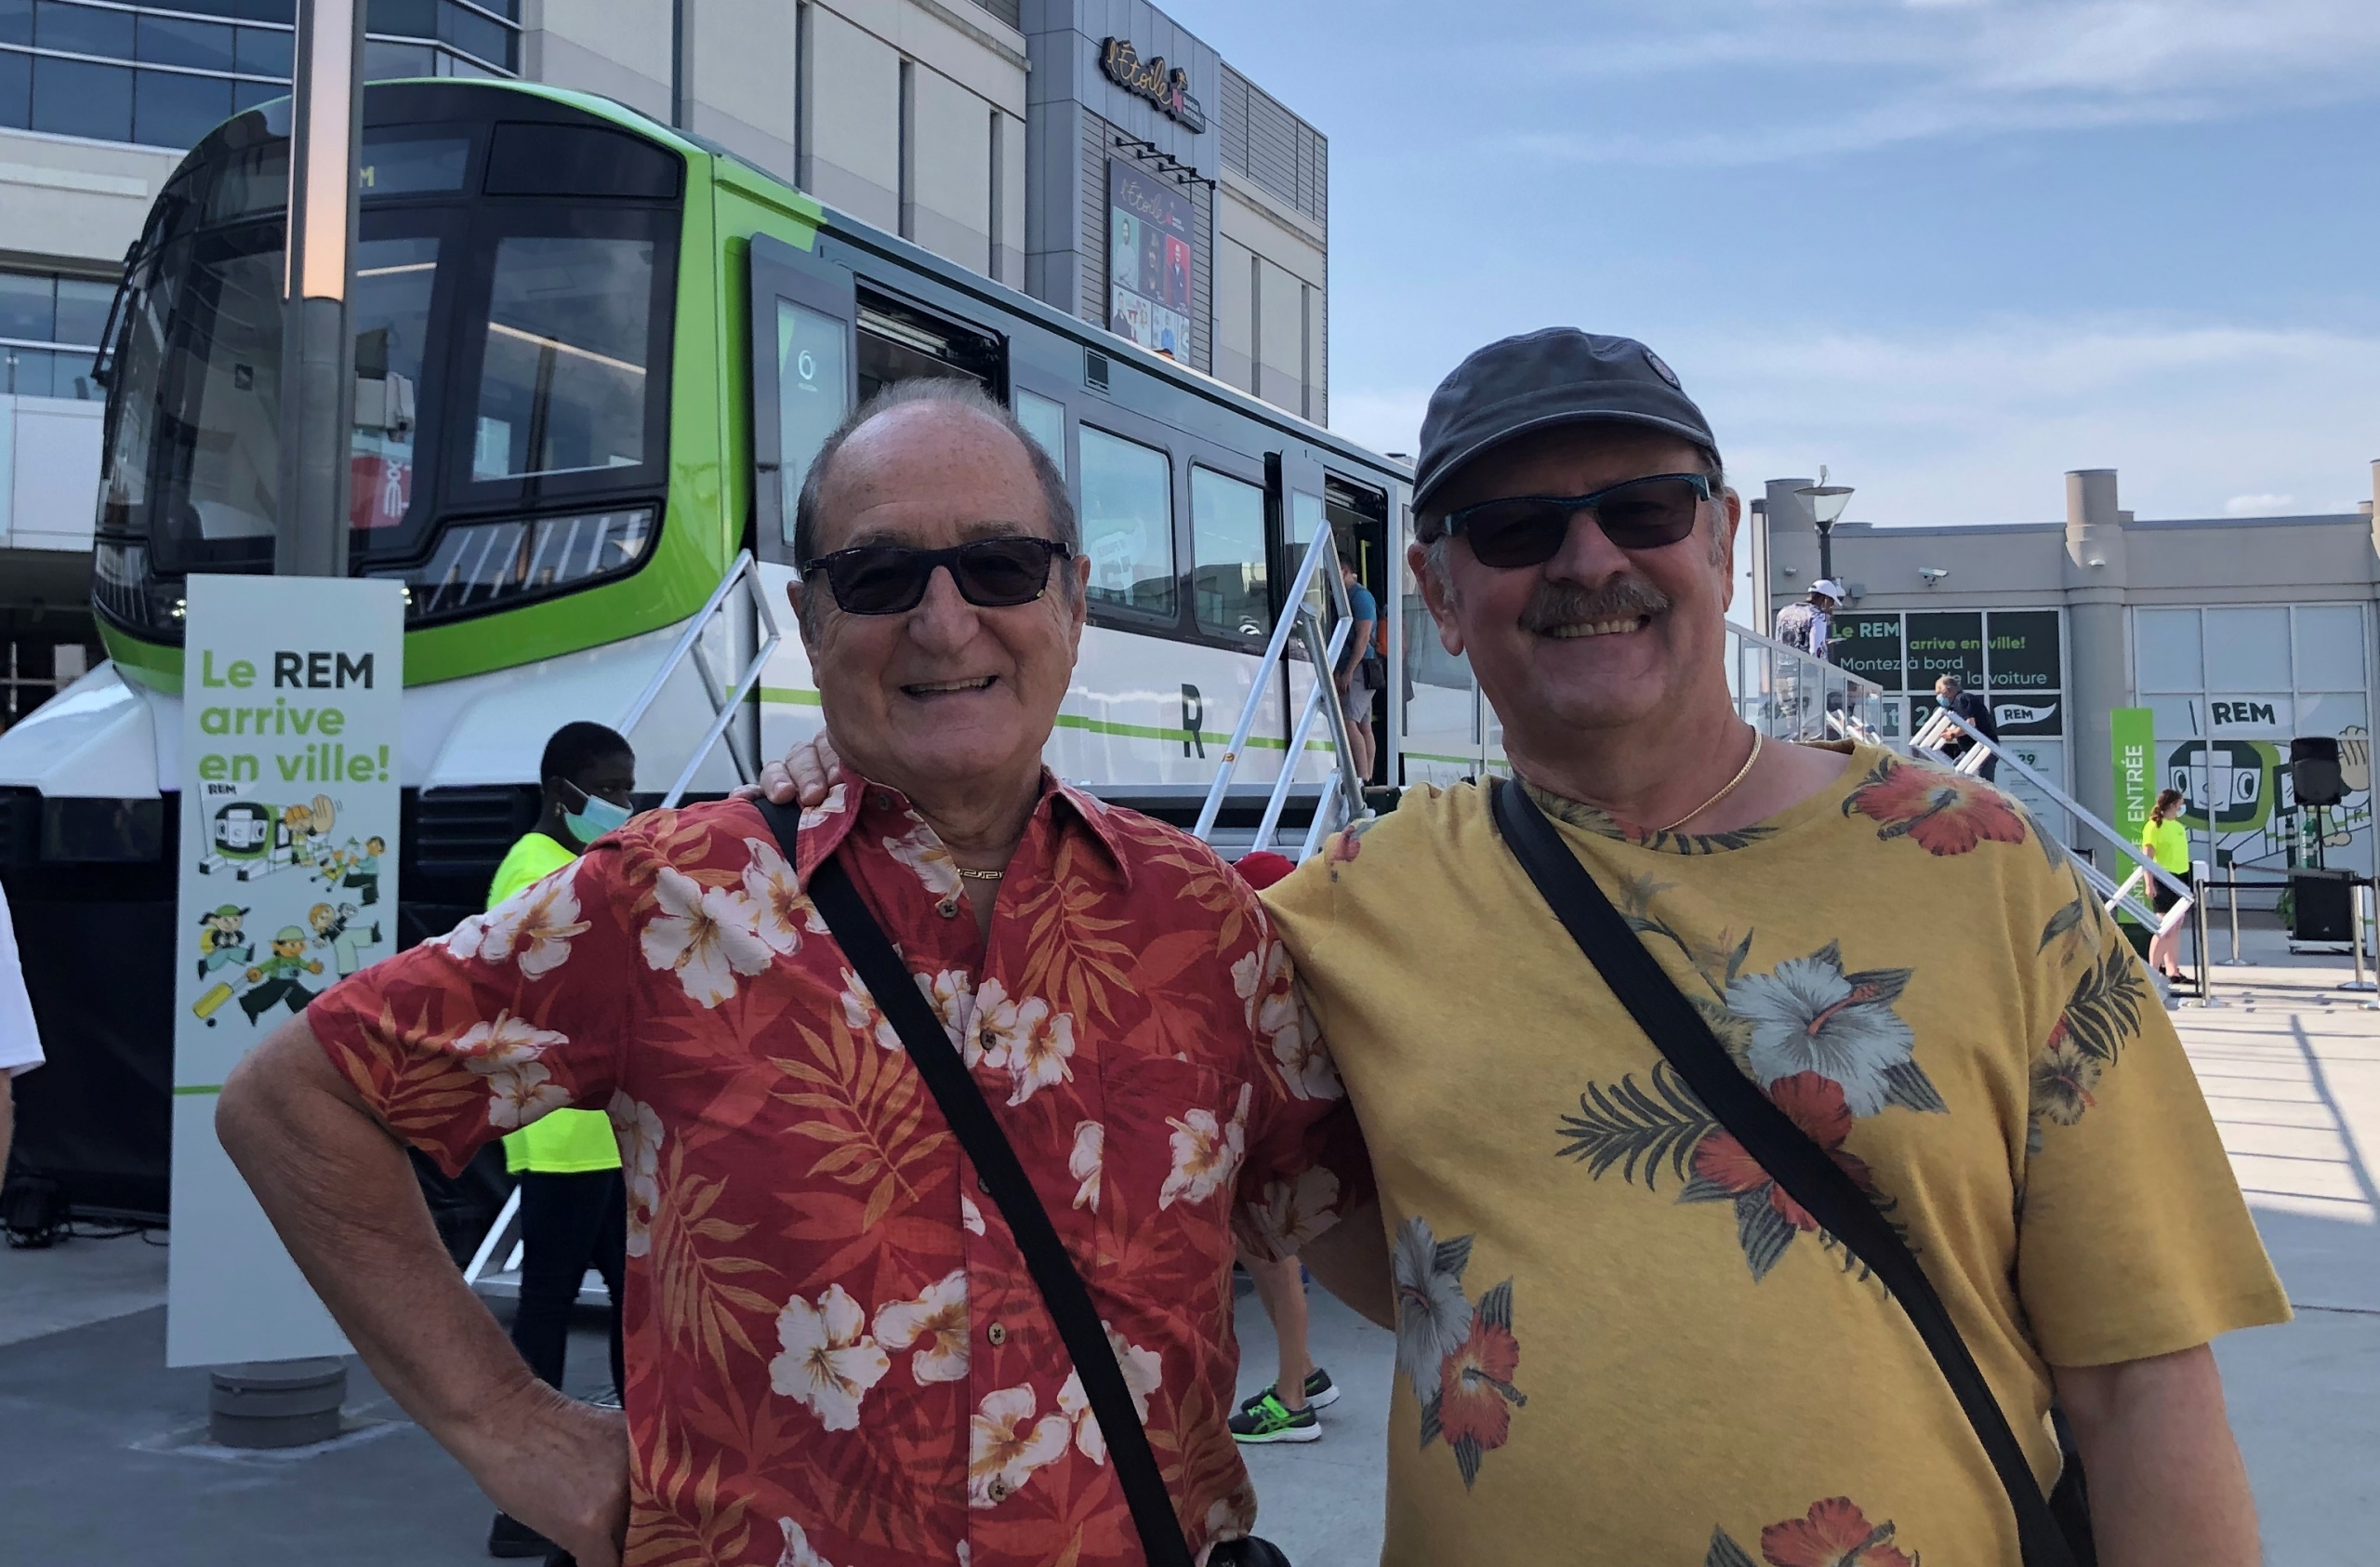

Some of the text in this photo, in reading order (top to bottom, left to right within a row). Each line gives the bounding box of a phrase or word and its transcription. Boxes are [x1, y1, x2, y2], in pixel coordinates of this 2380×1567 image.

[1107, 40, 1171, 104] l'Étoile
[1832, 622, 1899, 638] Le REM
[1910, 636, 2026, 650] arrive en ville!
[203, 649, 374, 689] Le REM
[1840, 656, 1964, 671] Montez à bord
[1966, 671, 1982, 684] la
[1989, 671, 2047, 685] voiture
[200, 696, 345, 736] arrive
[1182, 684, 1205, 759] R
[2004, 709, 2033, 721] REM
[2212, 702, 2276, 724] REM
[199, 743, 390, 782] en ville!
[208, 783, 236, 795] REM
[2121, 745, 2145, 822] ENTRÉE
